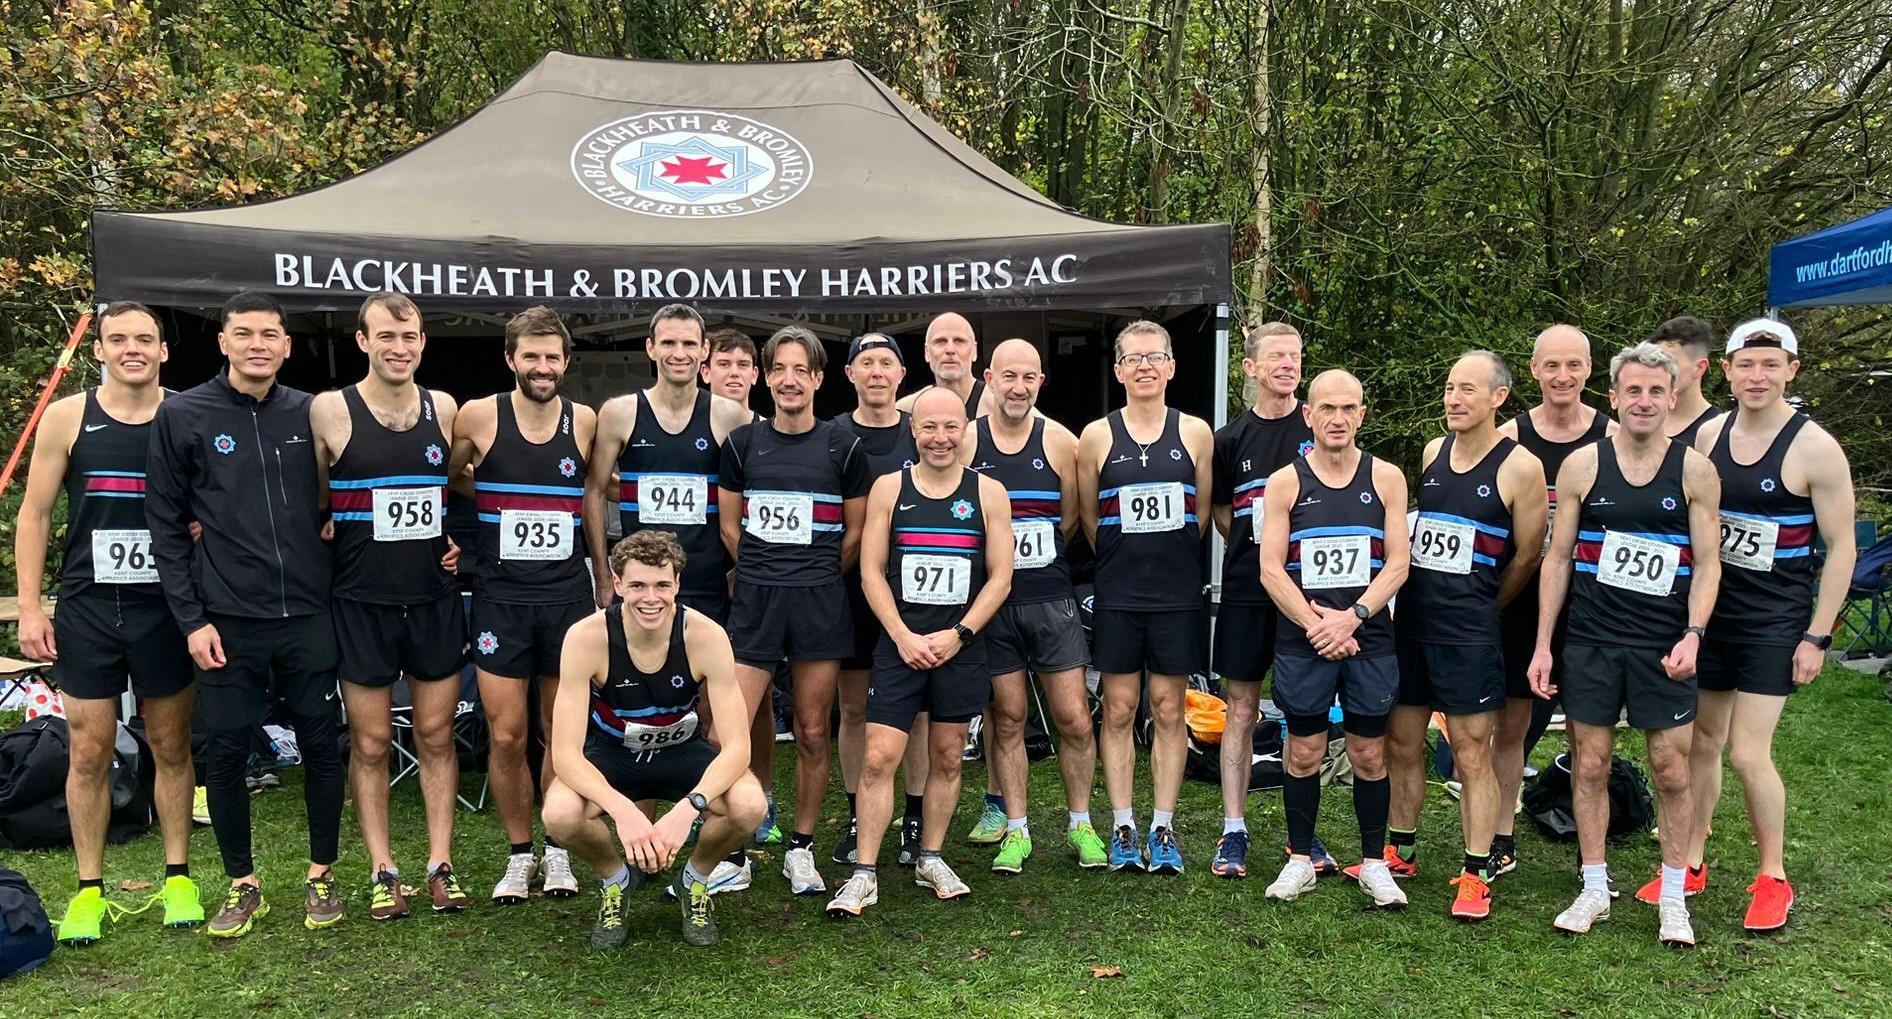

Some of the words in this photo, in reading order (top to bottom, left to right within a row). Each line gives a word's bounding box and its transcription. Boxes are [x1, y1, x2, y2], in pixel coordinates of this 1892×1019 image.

[583, 115, 700, 179] BLACKHEATH
[711, 117, 731, 134] &
[737, 124, 804, 186] BROMLEY
[596, 184, 745, 217] HARRIERS
[752, 189, 787, 209] AC
[274, 253, 554, 297] BLACKHEATH
[569, 268, 599, 298] &
[613, 267, 807, 298] BROMLEY
[821, 259, 1013, 297] HARRIERS
[1025, 253, 1078, 286] AC
[651, 487, 695, 512] 944
[1131, 495, 1171, 521] 981
[388, 500, 433, 528] 958
[759, 505, 800, 531] 956
[514, 522, 560, 548] 935
[1421, 529, 1461, 560] 959
[1720, 524, 1761, 557] 975
[1313, 548, 1359, 576] 937
[1614, 546, 1664, 582] 950
[914, 566, 954, 593] 971
[638, 727, 685, 746] 986
